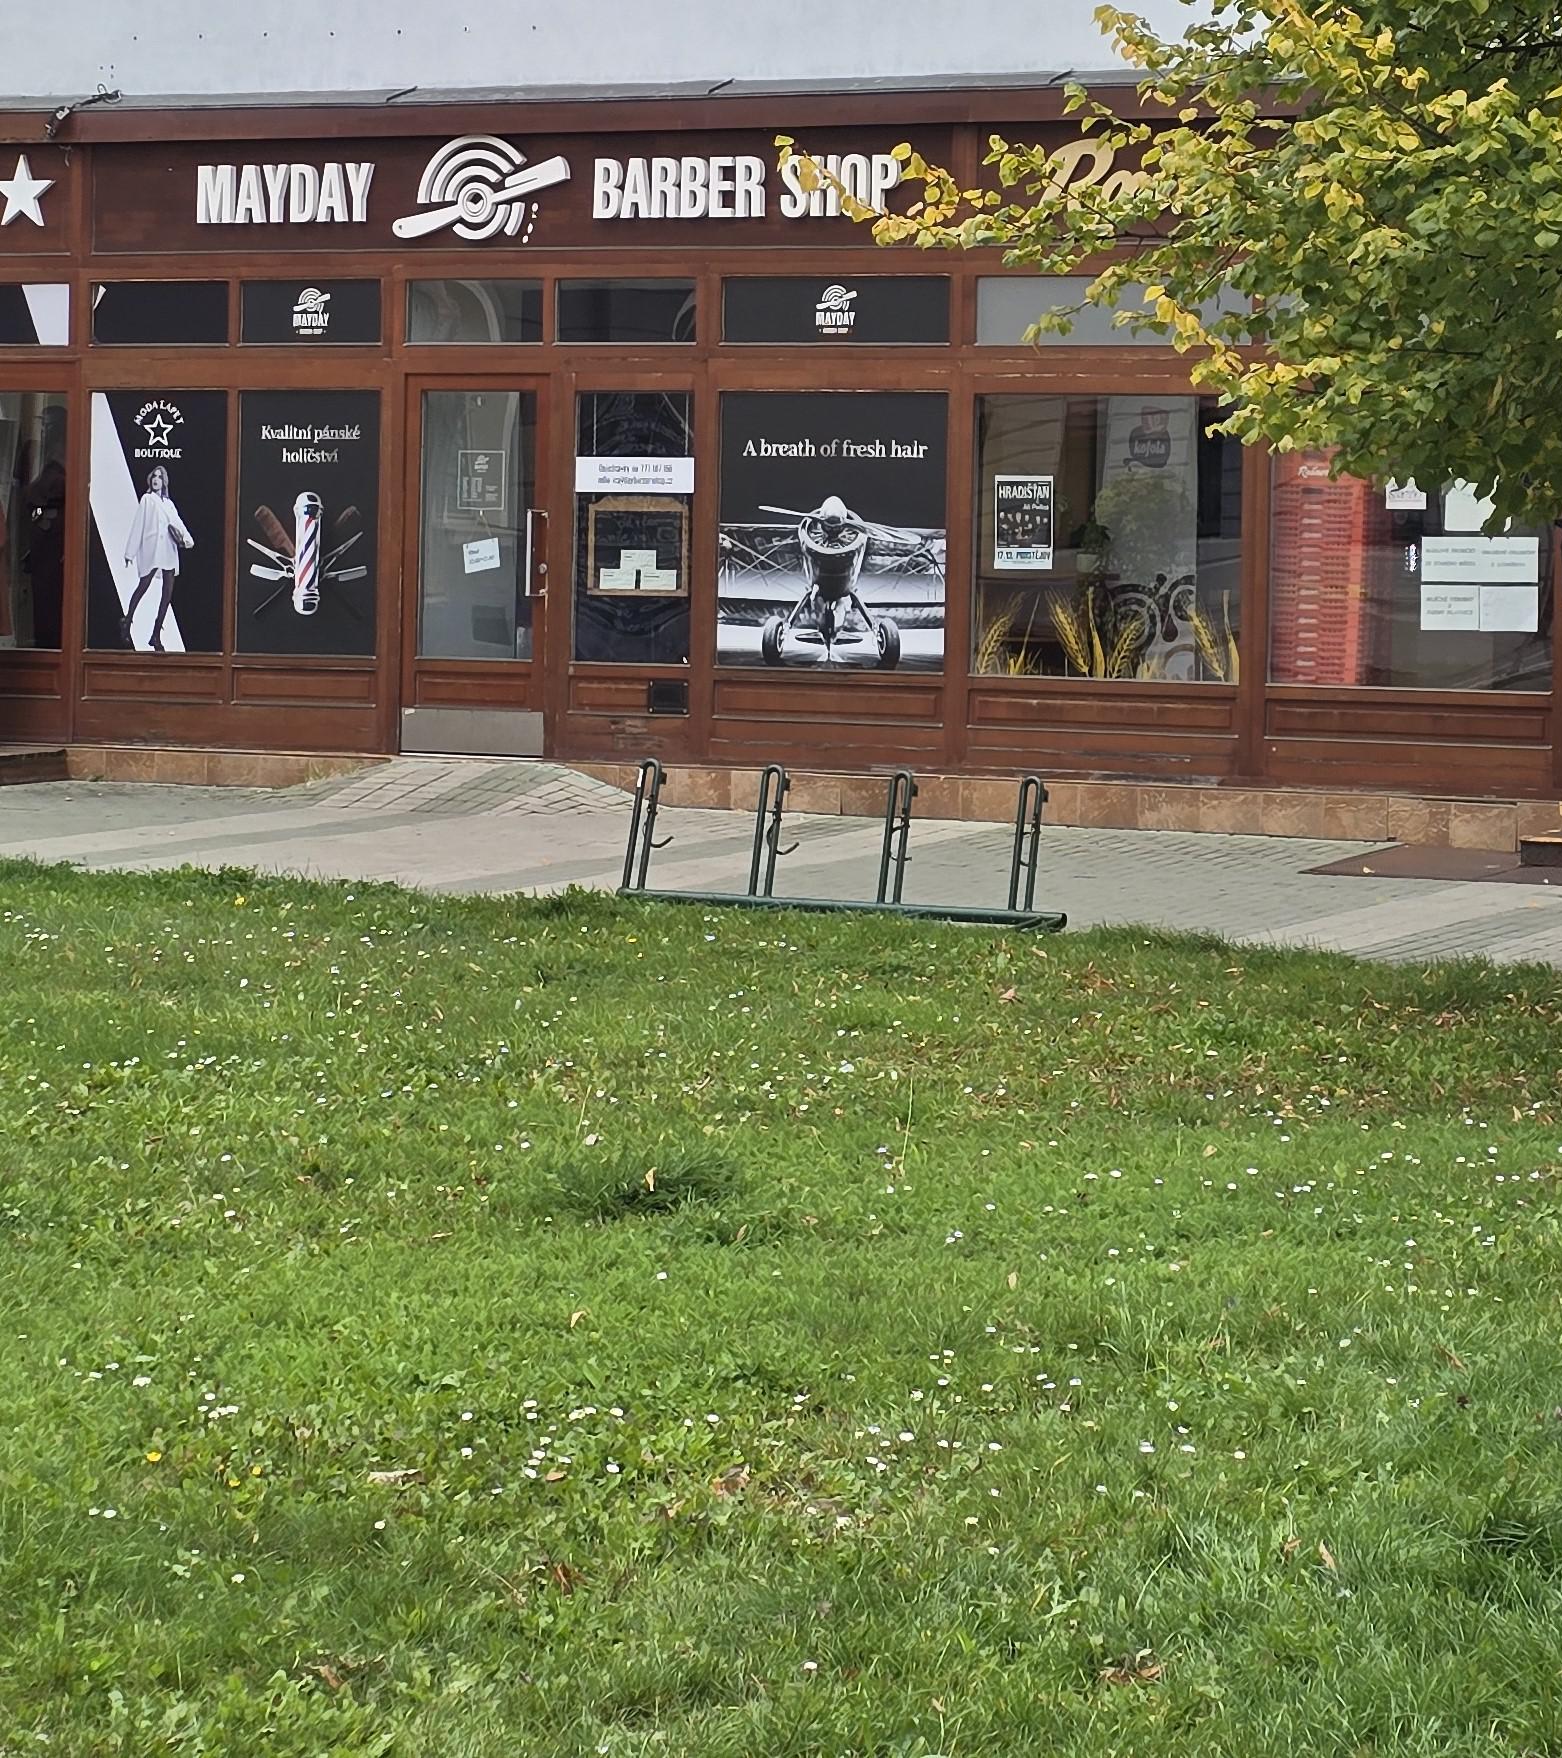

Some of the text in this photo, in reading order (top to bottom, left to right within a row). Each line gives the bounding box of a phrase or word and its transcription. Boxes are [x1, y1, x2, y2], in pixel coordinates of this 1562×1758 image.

[197, 153, 905, 224] MAYDAY BARBER SHOP
[293, 313, 329, 327] MAYDAY
[816, 311, 855, 326] MAYDAY
[261, 424, 360, 443] Kvalitní pánské
[135, 449, 182, 459] BOUTIQUE
[282, 447, 338, 463] holičství
[743, 439, 928, 459] A breath of fresh hair
